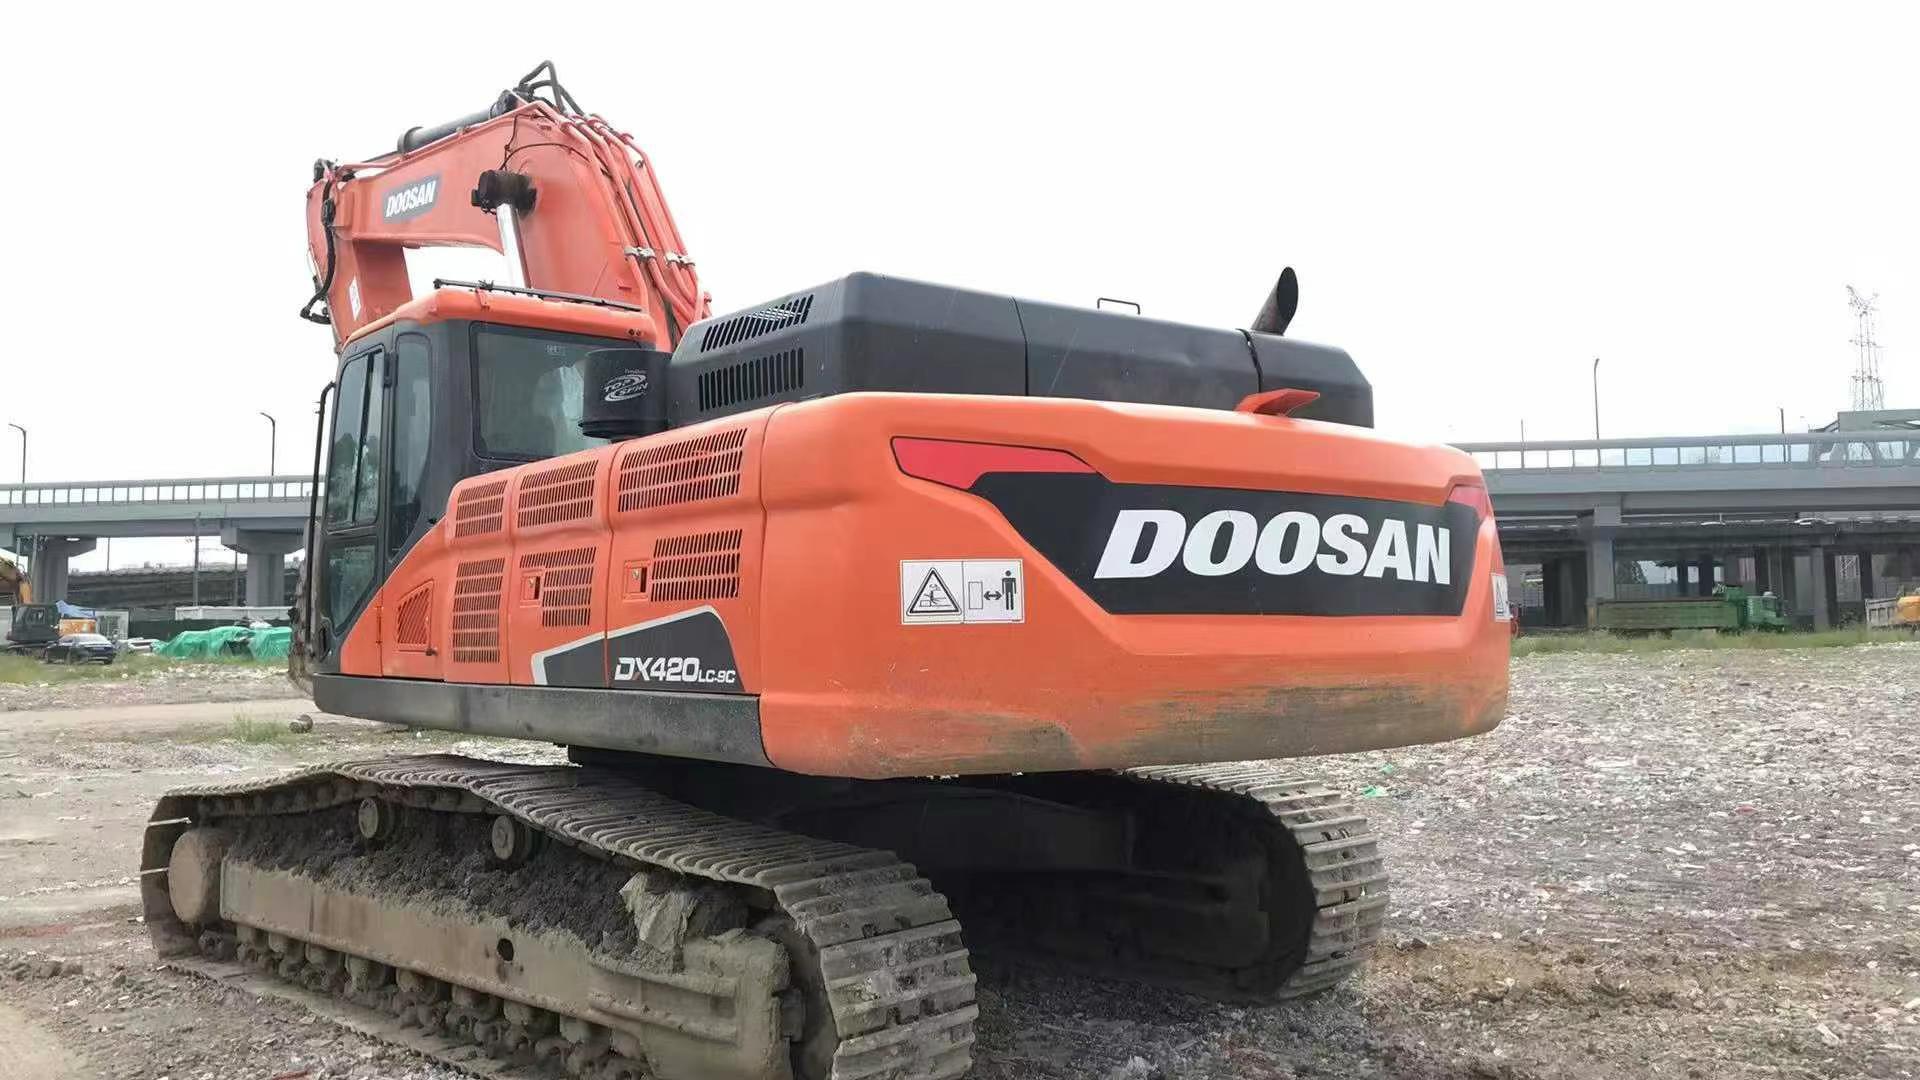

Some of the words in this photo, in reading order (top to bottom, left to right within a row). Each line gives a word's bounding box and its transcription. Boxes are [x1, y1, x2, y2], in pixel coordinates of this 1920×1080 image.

[385, 180, 437, 218] DOOSAN
[618, 382, 649, 396] SPIN
[1094, 509, 1451, 585] DOOSAN
